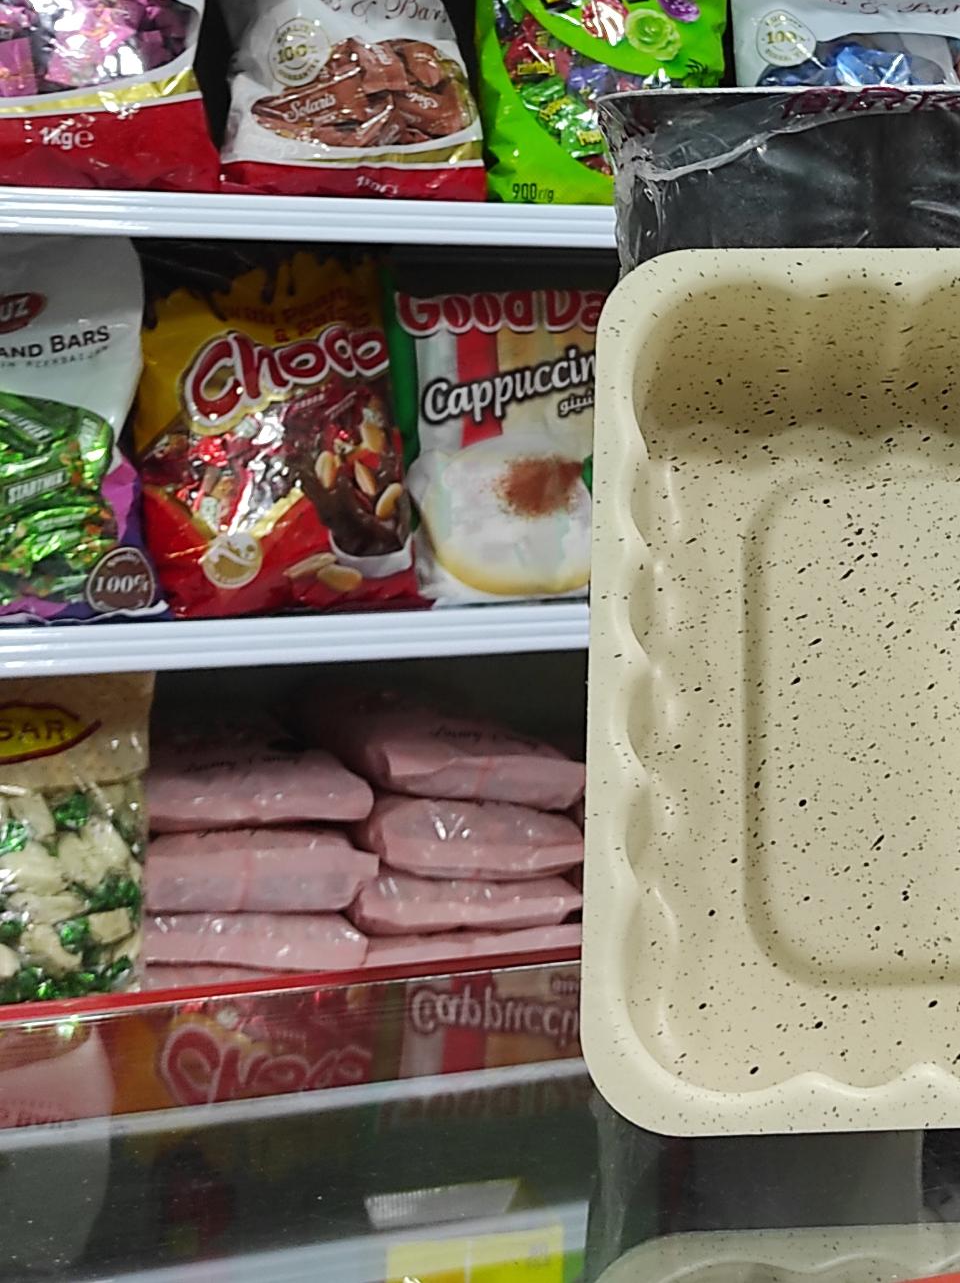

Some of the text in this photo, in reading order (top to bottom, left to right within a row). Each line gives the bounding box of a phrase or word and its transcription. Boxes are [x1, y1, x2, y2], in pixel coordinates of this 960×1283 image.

[283, 93, 337, 122] Solaris
[545, 291, 602, 332] Da
[50, 325, 111, 354] BARS
[423, 348, 597, 423] Cappuccin
[95, 573, 149, 593] 100%
